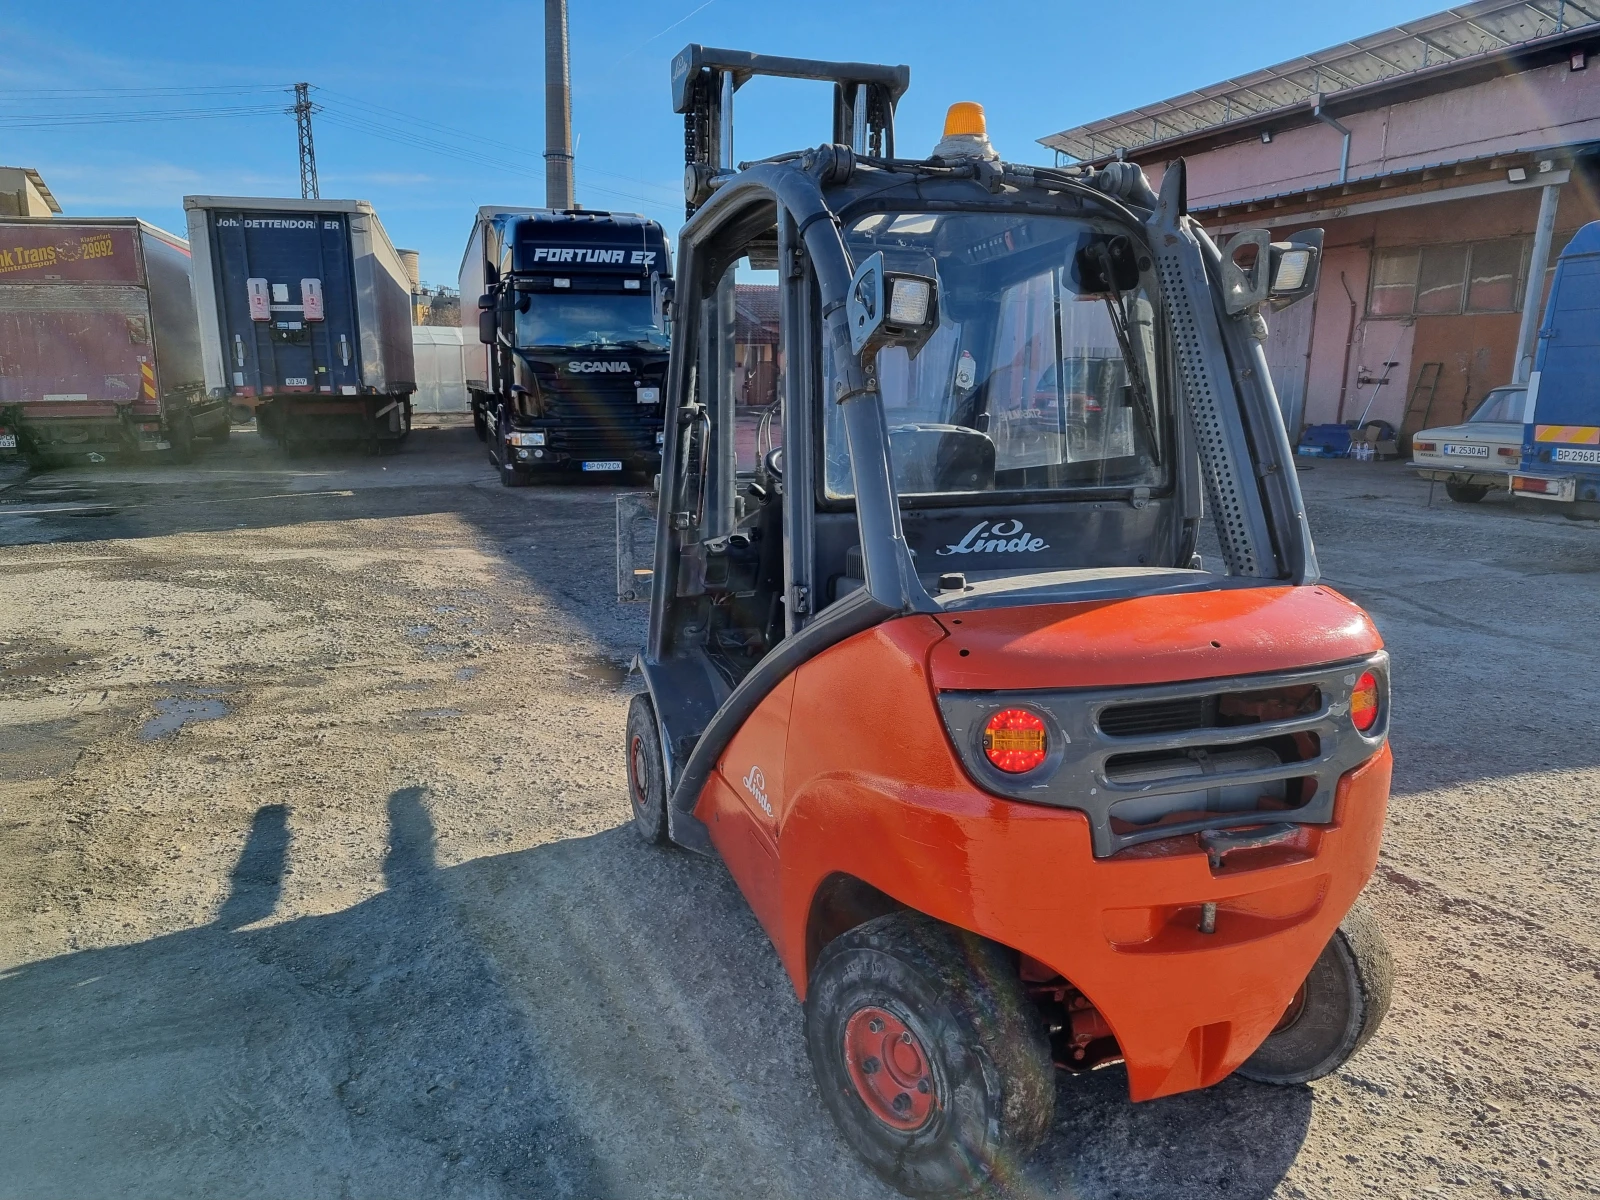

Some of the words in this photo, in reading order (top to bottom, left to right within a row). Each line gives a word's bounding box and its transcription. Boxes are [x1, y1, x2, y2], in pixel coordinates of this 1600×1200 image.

[216, 218, 240, 227] Joh.
[244, 219, 340, 230] DETTENDORER
[14, 246, 56, 265] Trans
[81, 239, 114, 260] 29992
[533, 248, 625, 264] FORTUNA
[630, 251, 657, 265] EZ
[568, 361, 632, 373] SCANIA
[935, 518, 1051, 556] Linde
[742, 765, 774, 818] Linde
